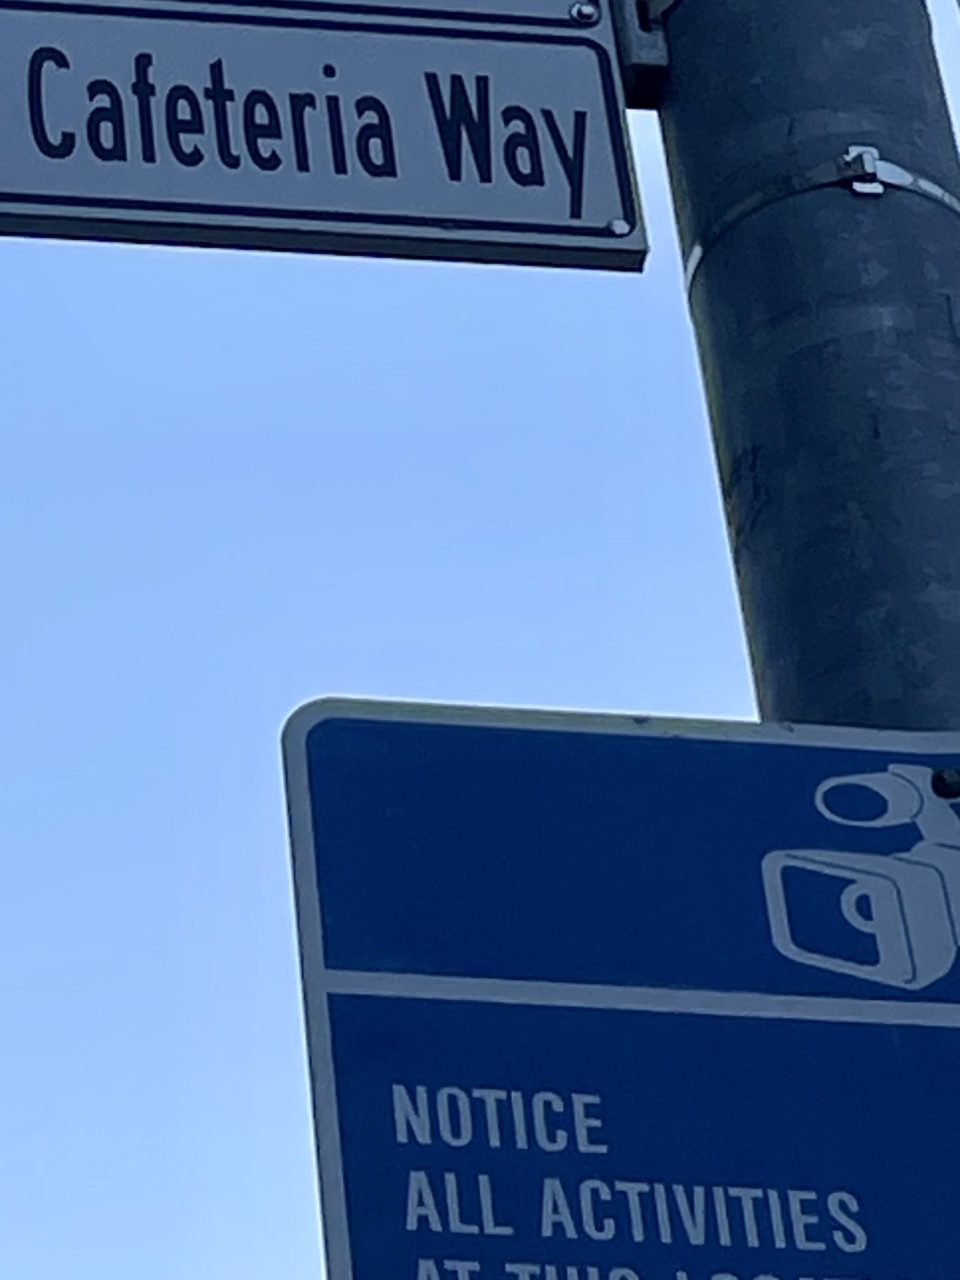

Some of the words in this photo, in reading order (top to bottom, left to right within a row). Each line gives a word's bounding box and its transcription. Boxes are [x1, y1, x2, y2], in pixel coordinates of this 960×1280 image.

[27, 46, 398, 179] Cafeteria
[423, 71, 589, 220] Way
[391, 1083, 609, 1154] NOTICE
[405, 1170, 515, 1237] ALL
[540, 1177, 868, 1253] ACTIVITIES
